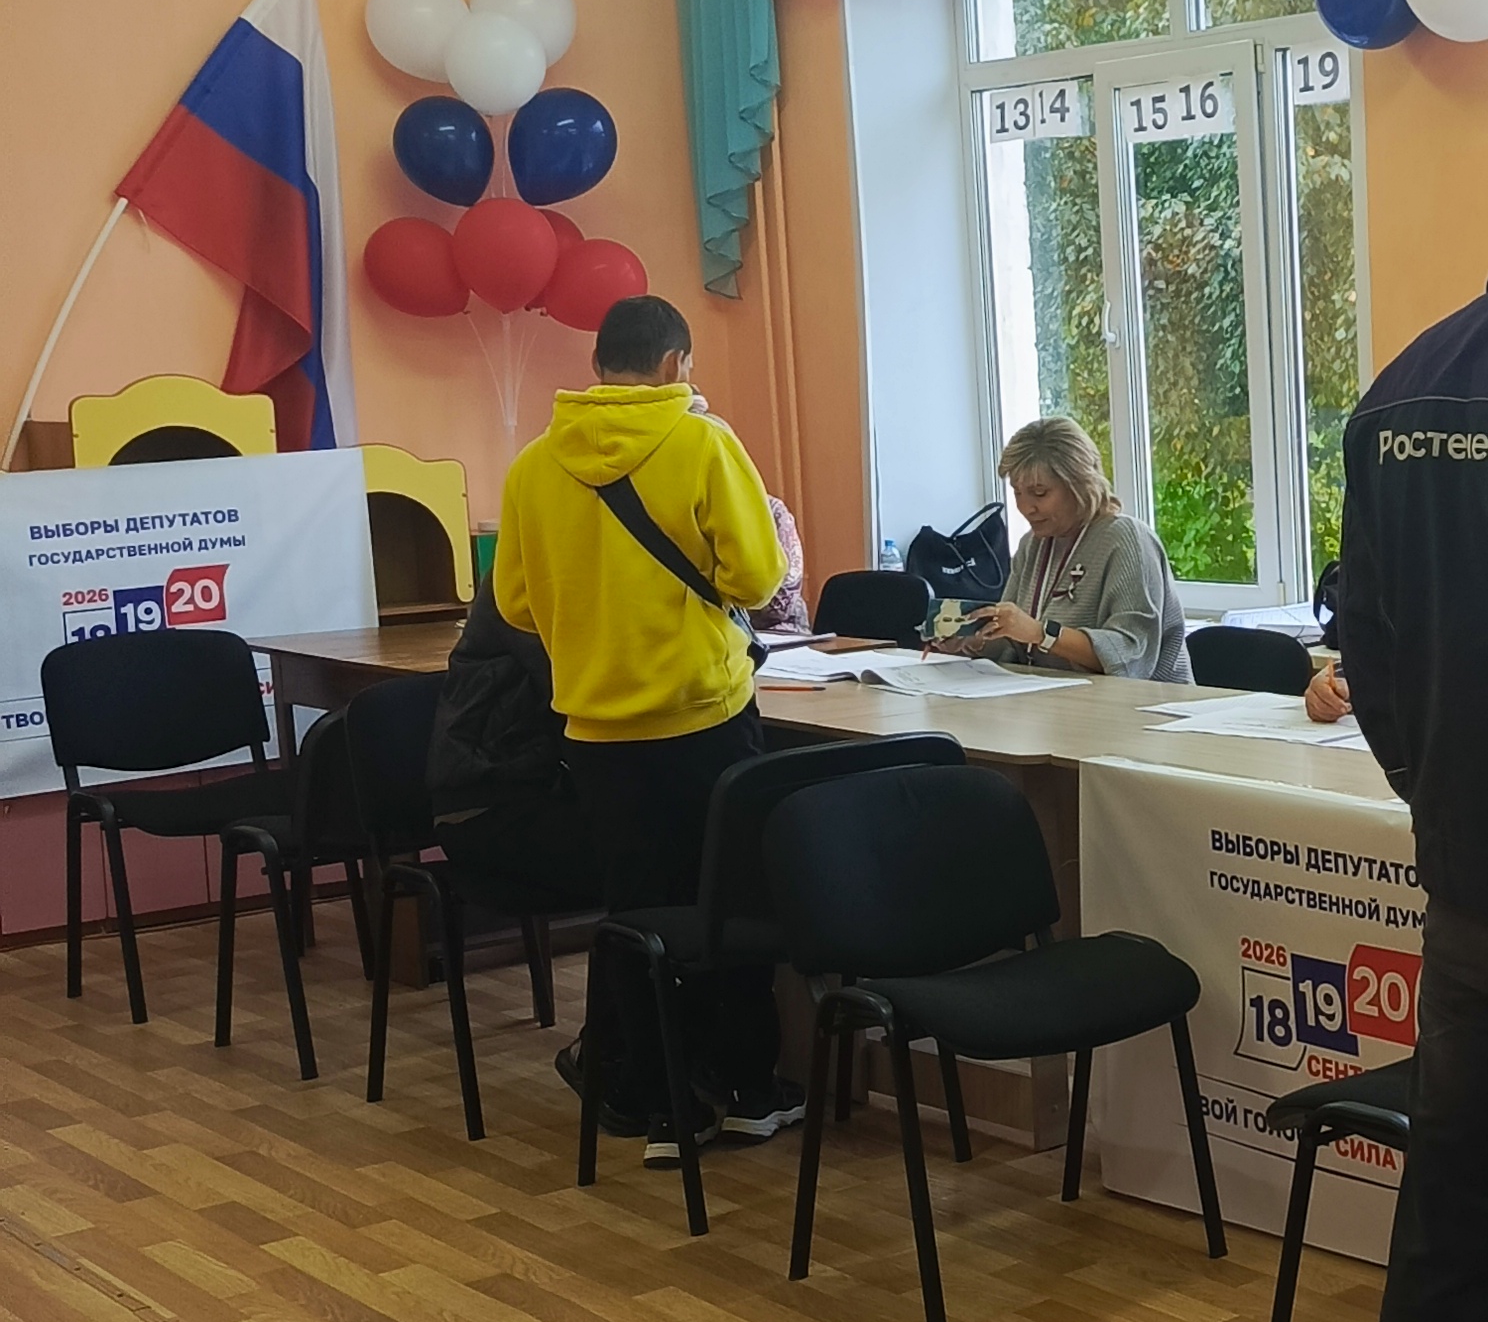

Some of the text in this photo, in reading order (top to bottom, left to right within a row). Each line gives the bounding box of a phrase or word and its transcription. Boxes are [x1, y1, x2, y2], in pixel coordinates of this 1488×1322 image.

[1297, 51, 1340, 93] 19
[995, 98, 1031, 134] 13
[1130, 95, 1169, 133] 15
[1180, 81, 1220, 122] 16
[30, 509, 240, 540] ВЫБОРЫ ДЕПУТАТОВ
[28, 535, 247, 567] ГОСУДАРСТВЕННОЙ ДУМЫ
[62, 589, 109, 606] 2026
[120, 600, 162, 633] 19
[169, 578, 221, 614] 20
[1, 711, 44, 730] ТВО
[1211, 829, 1420, 888] ВЫБОРЫ ДЕПУТАТО
[1209, 871, 1427, 928] ГОСУДАРСТВЕННОЙ ДУМ
[1240, 937, 1288, 967] 2026
[1249, 966, 1410, 1047] 18 19 20
[1335, 1137, 1397, 1171] СИЛА
